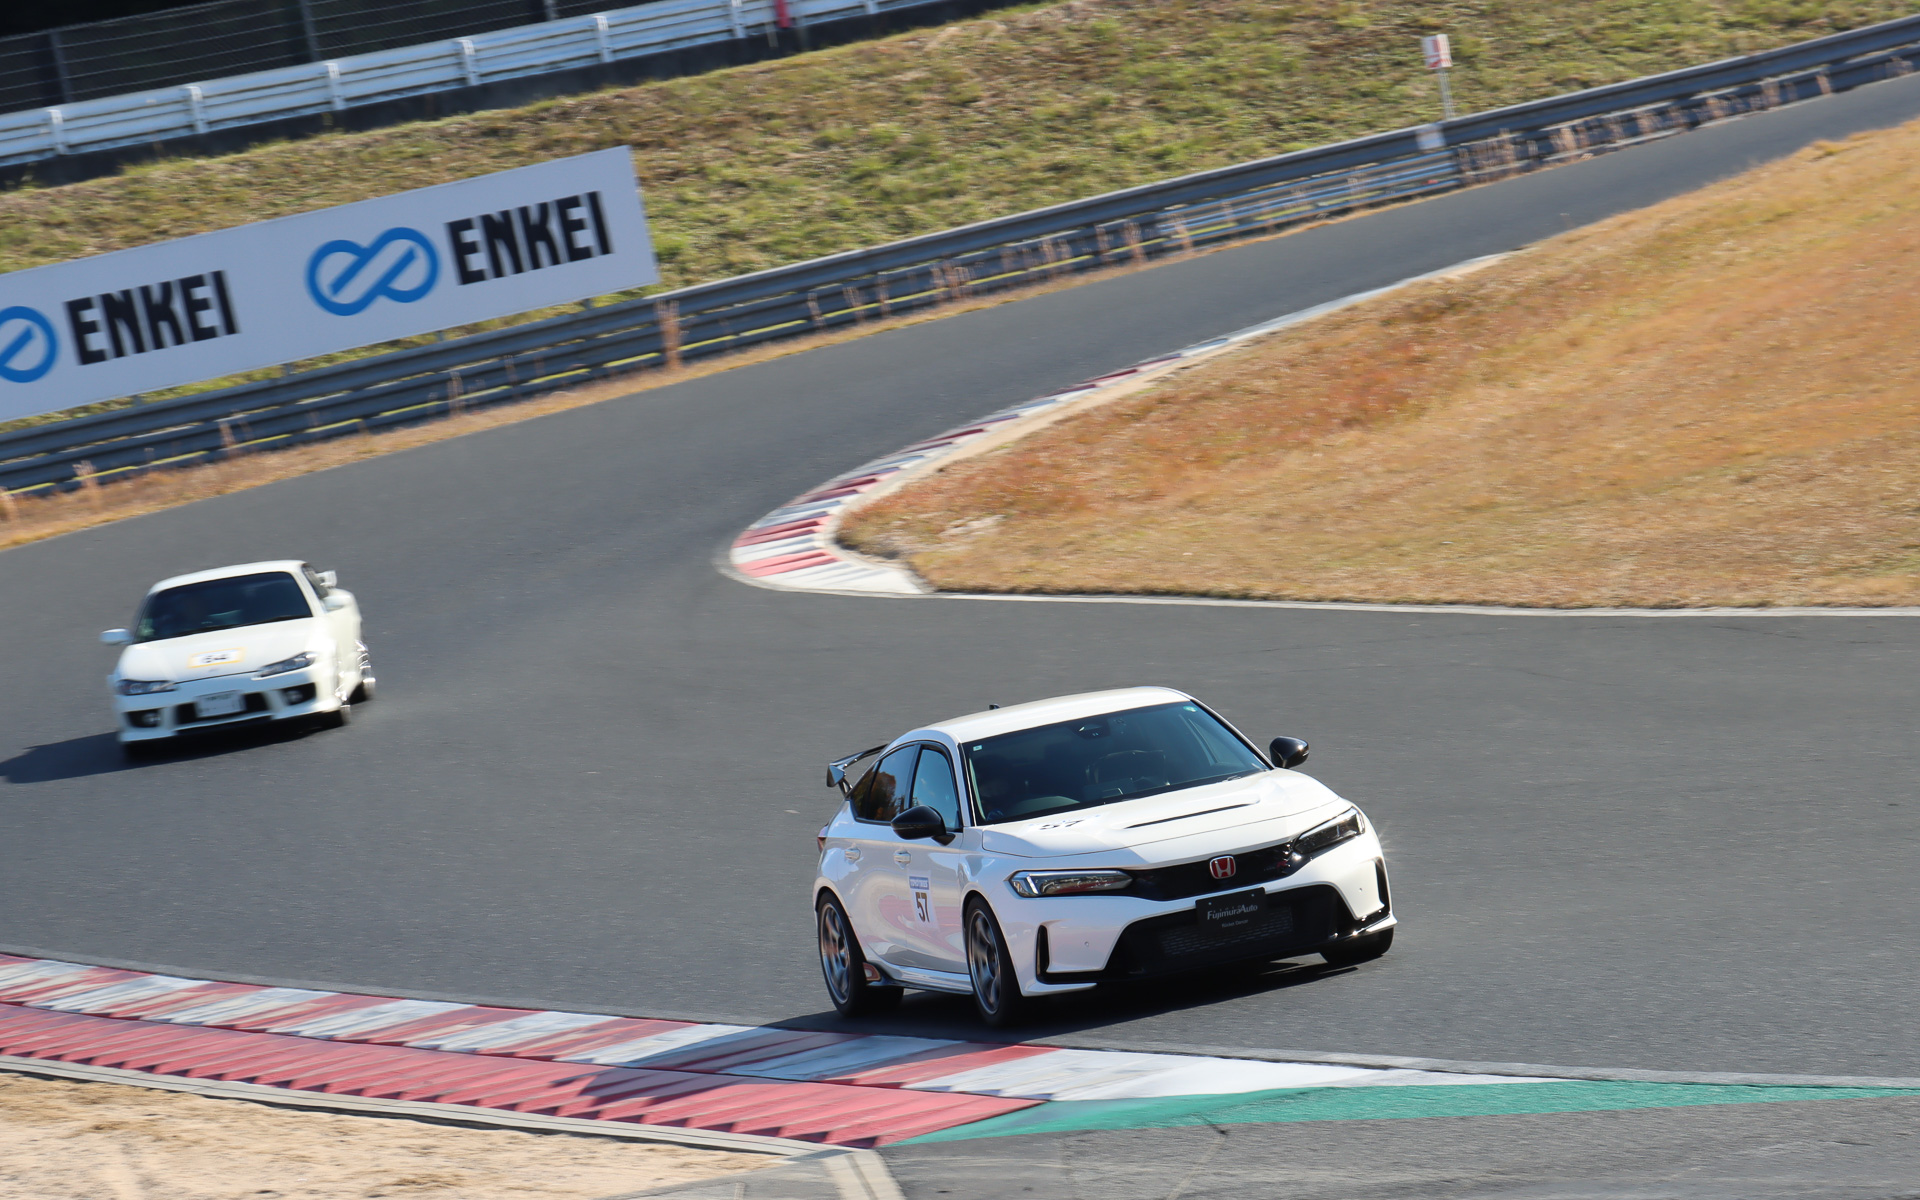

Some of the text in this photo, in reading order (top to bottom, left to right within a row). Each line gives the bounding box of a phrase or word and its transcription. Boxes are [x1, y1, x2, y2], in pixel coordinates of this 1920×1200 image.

[444, 190, 615, 286] ENKEI
[64, 269, 241, 366] ENKEI
[915, 891, 930, 922] 57
